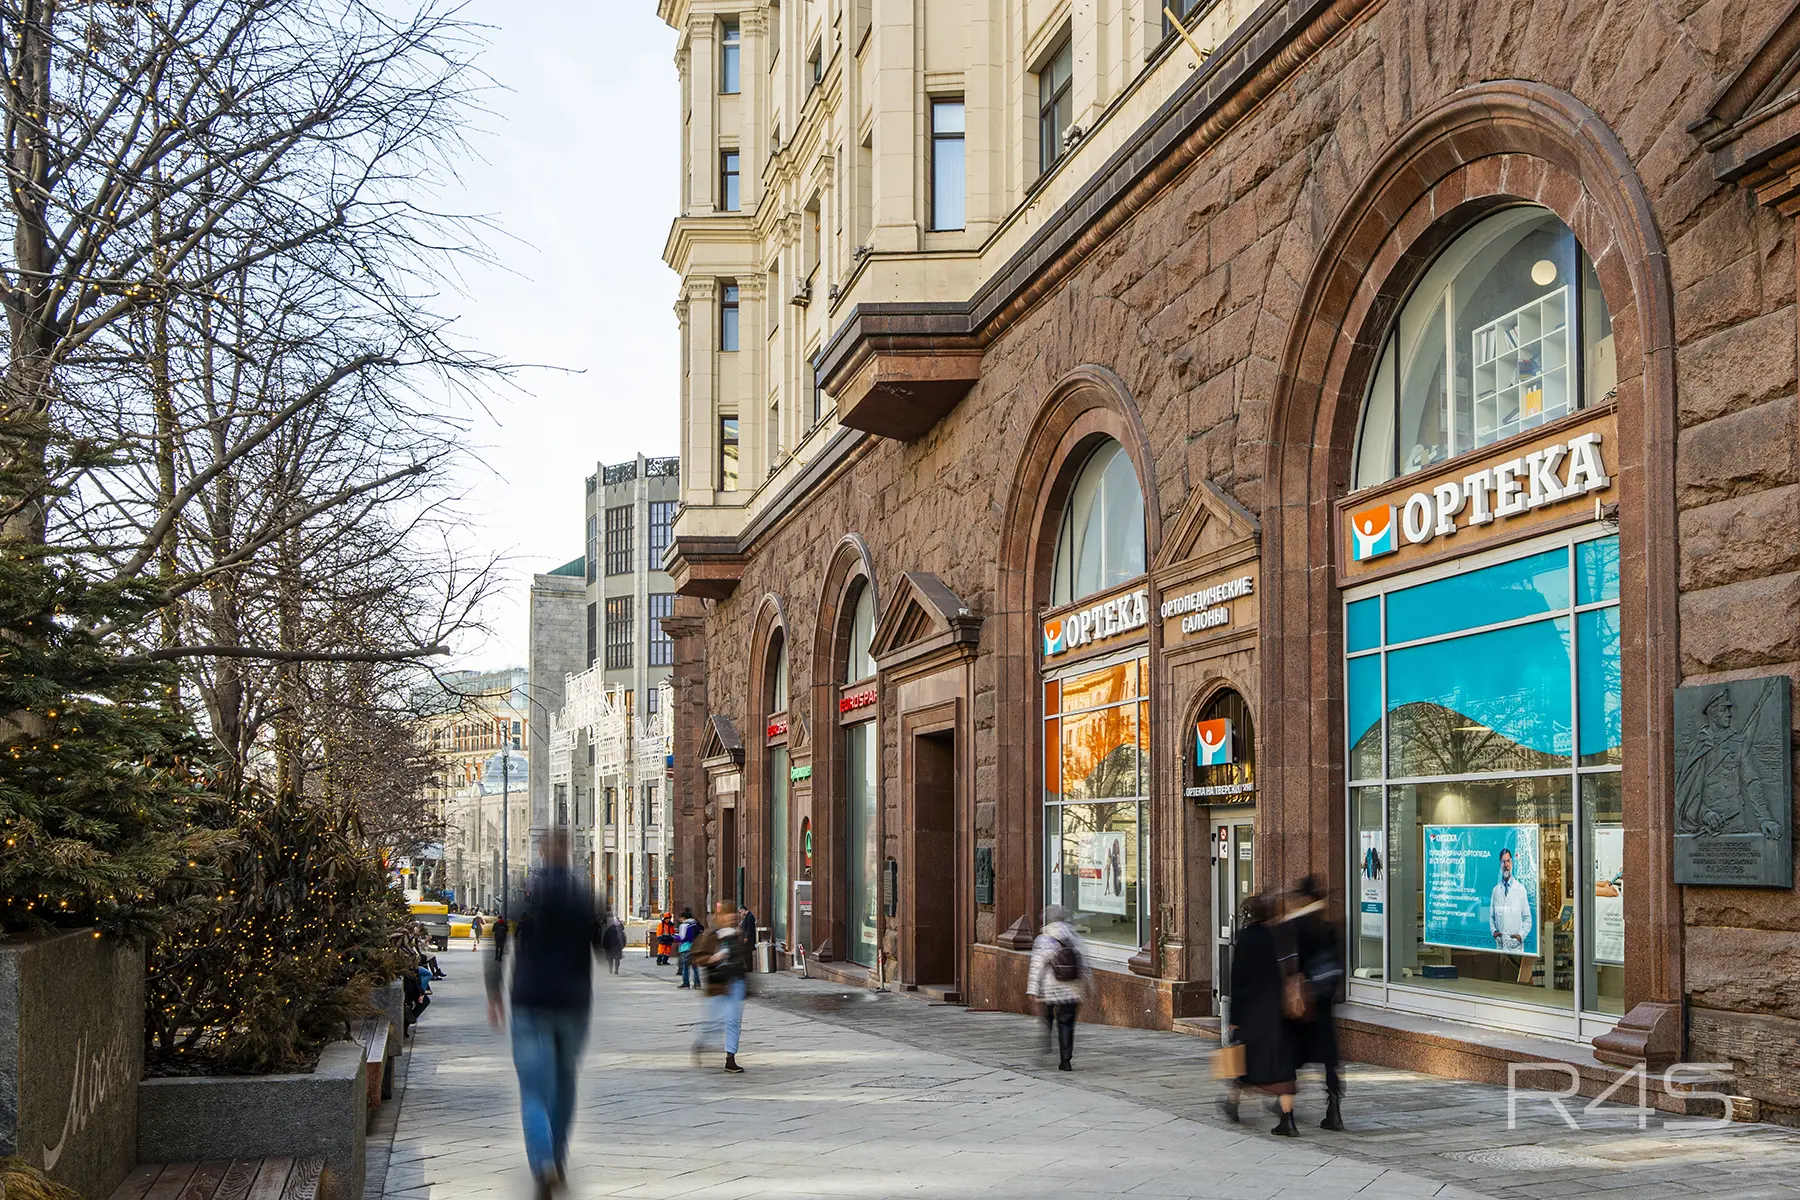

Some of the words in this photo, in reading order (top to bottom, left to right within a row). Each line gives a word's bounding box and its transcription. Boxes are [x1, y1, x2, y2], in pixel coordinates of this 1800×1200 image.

[1403, 432, 1610, 544] ОРТЕКА
[1066, 589, 1148, 648] ОРТЕКА
[1161, 575, 1254, 618] ОРТОПЕДИЧЕСКИЕ
[1182, 606, 1229, 634] САЛОНЫ
